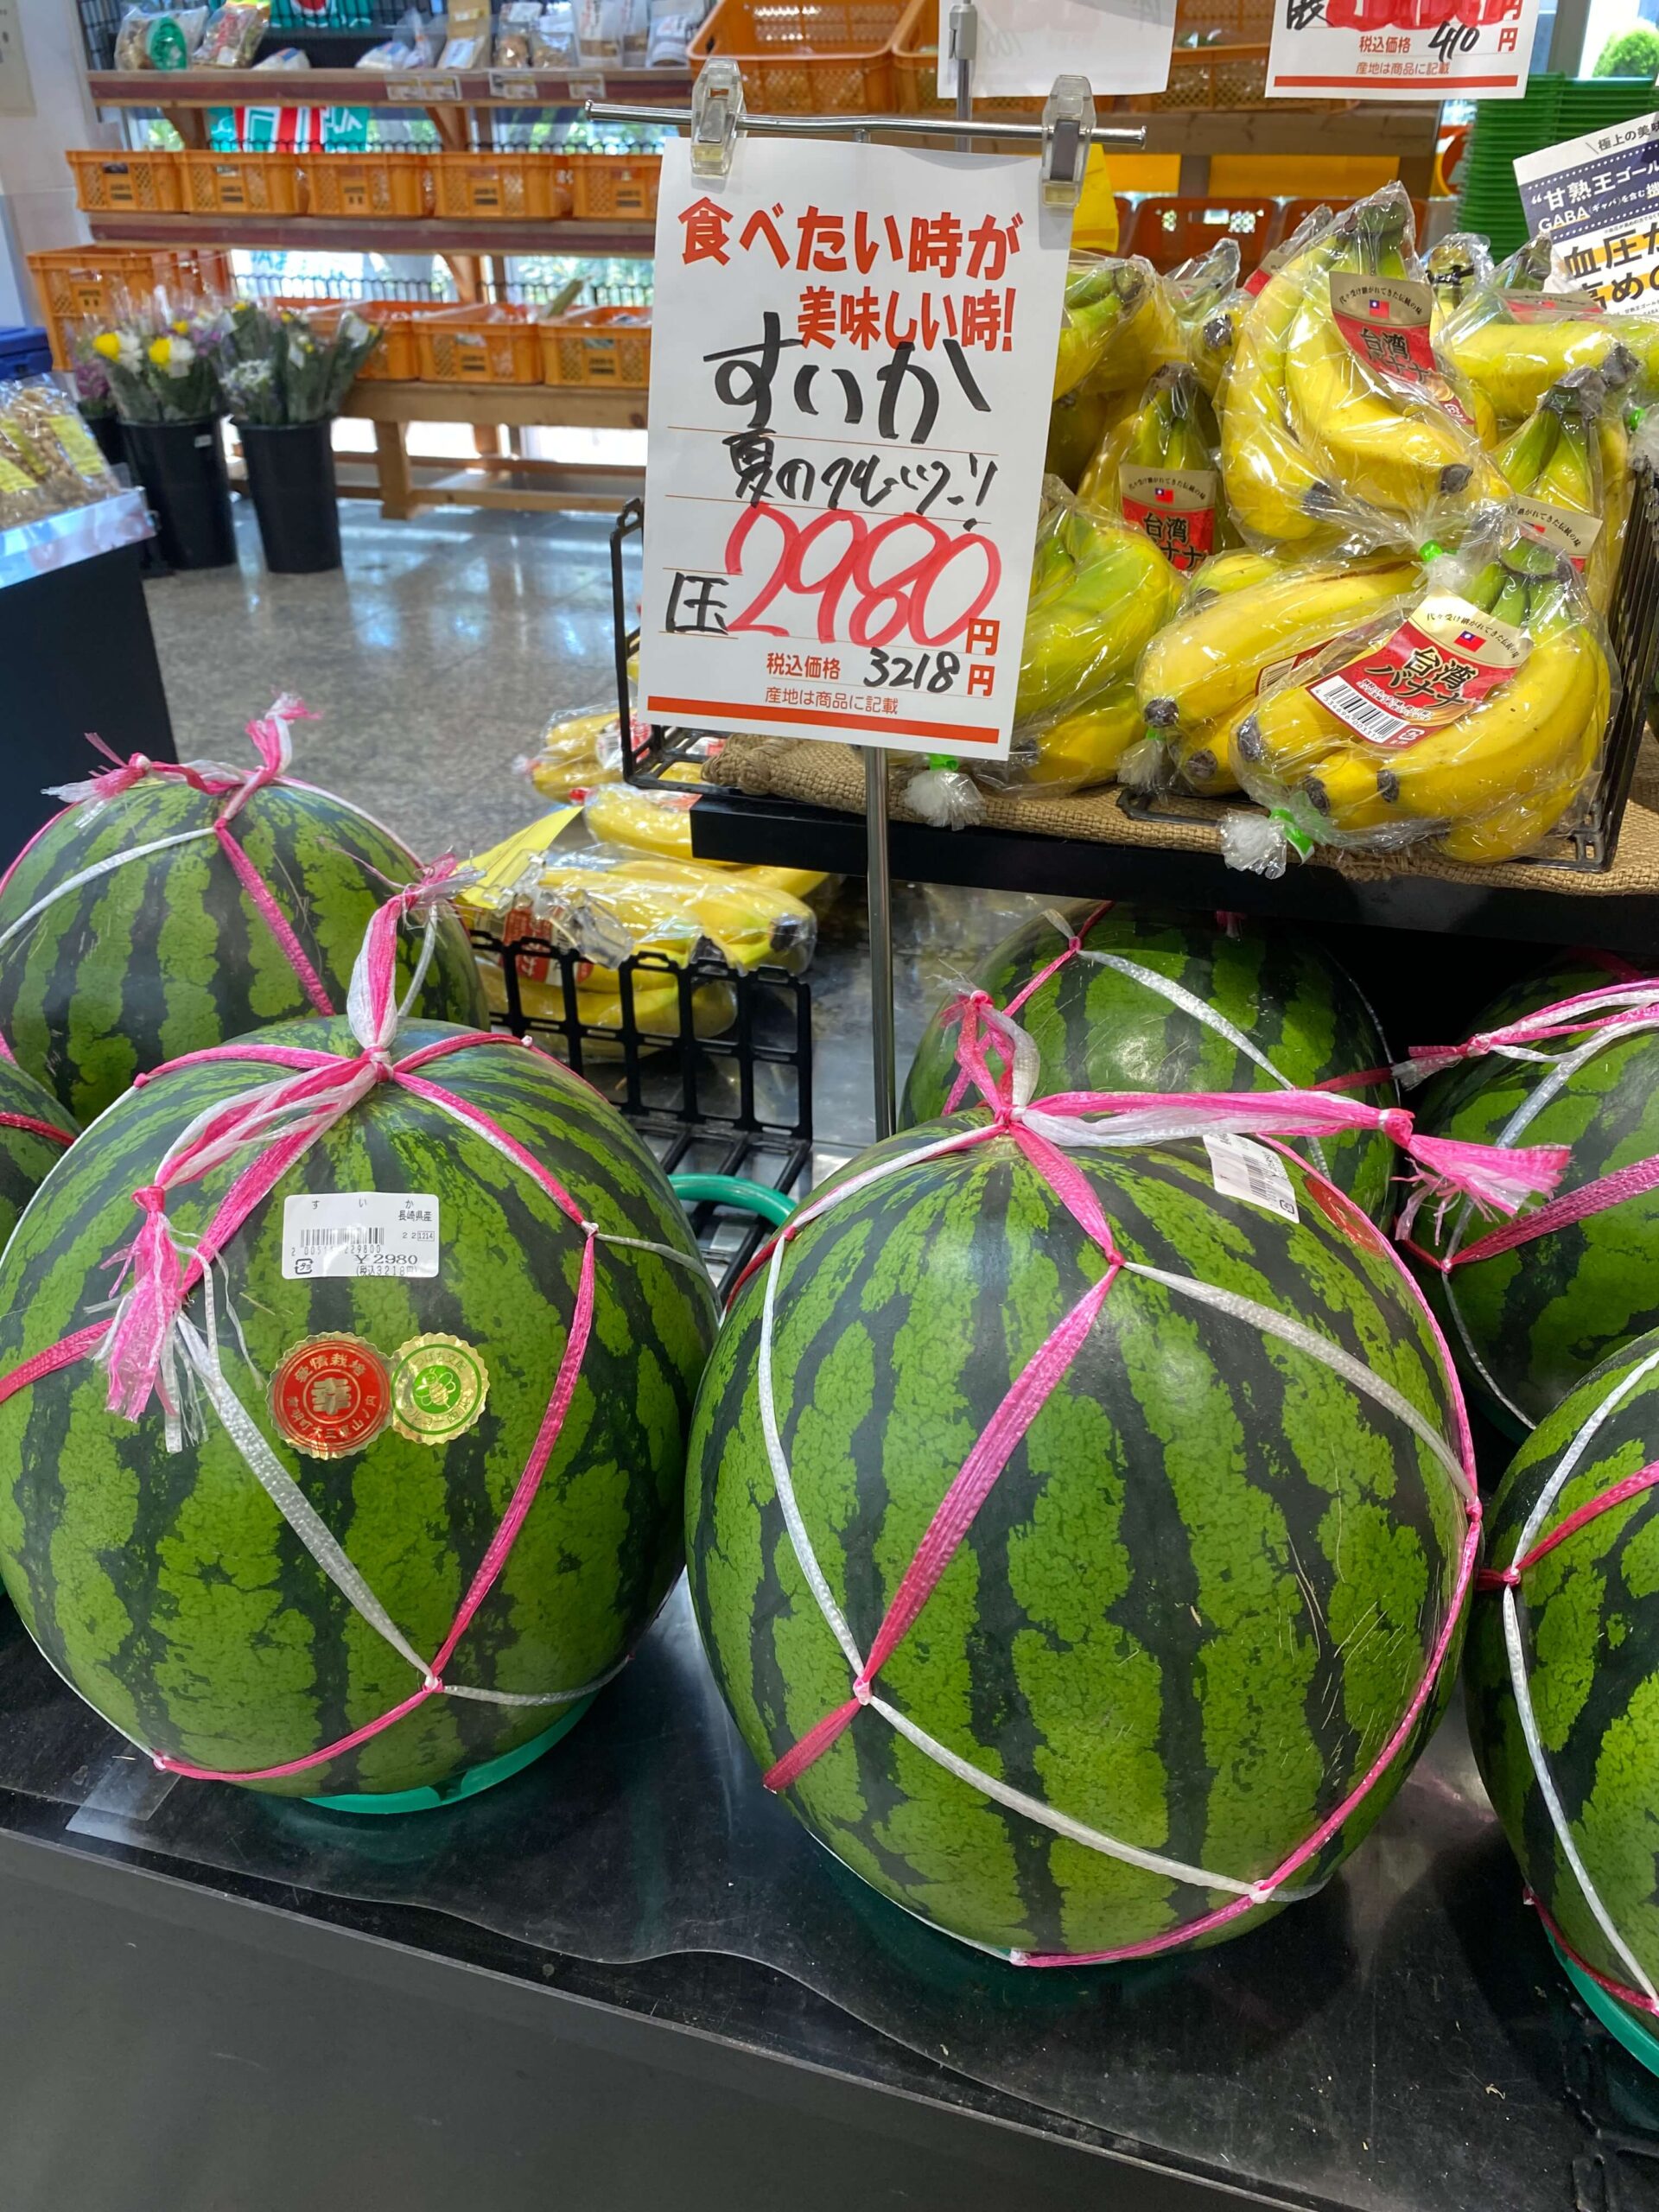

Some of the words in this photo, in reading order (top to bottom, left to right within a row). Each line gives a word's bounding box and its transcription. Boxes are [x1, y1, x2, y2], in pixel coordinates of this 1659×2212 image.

[1359, 35, 1411, 53] 税込価格
[1428, 21, 1480, 62] 410
[1497, 28, 1518, 52] 円
[1356, 61, 1451, 75] 産地は商品に記載
[677, 196, 1024, 281] 食べたい時が
[798, 285, 1017, 352] 美味しい時!
[703, 311, 991, 444] すいか
[1142, 511, 1188, 543] 台湾
[766, 652, 842, 680] 税込価格
[863, 646, 960, 692] 3218
[967, 664, 995, 696] 円
[1363, 664, 1466, 710] バナナ
[1402, 645, 1479, 691] 台湾
[765, 687, 899, 715] 産地は商品に記載
[398, 1210, 433, 1222] 長崎県産
